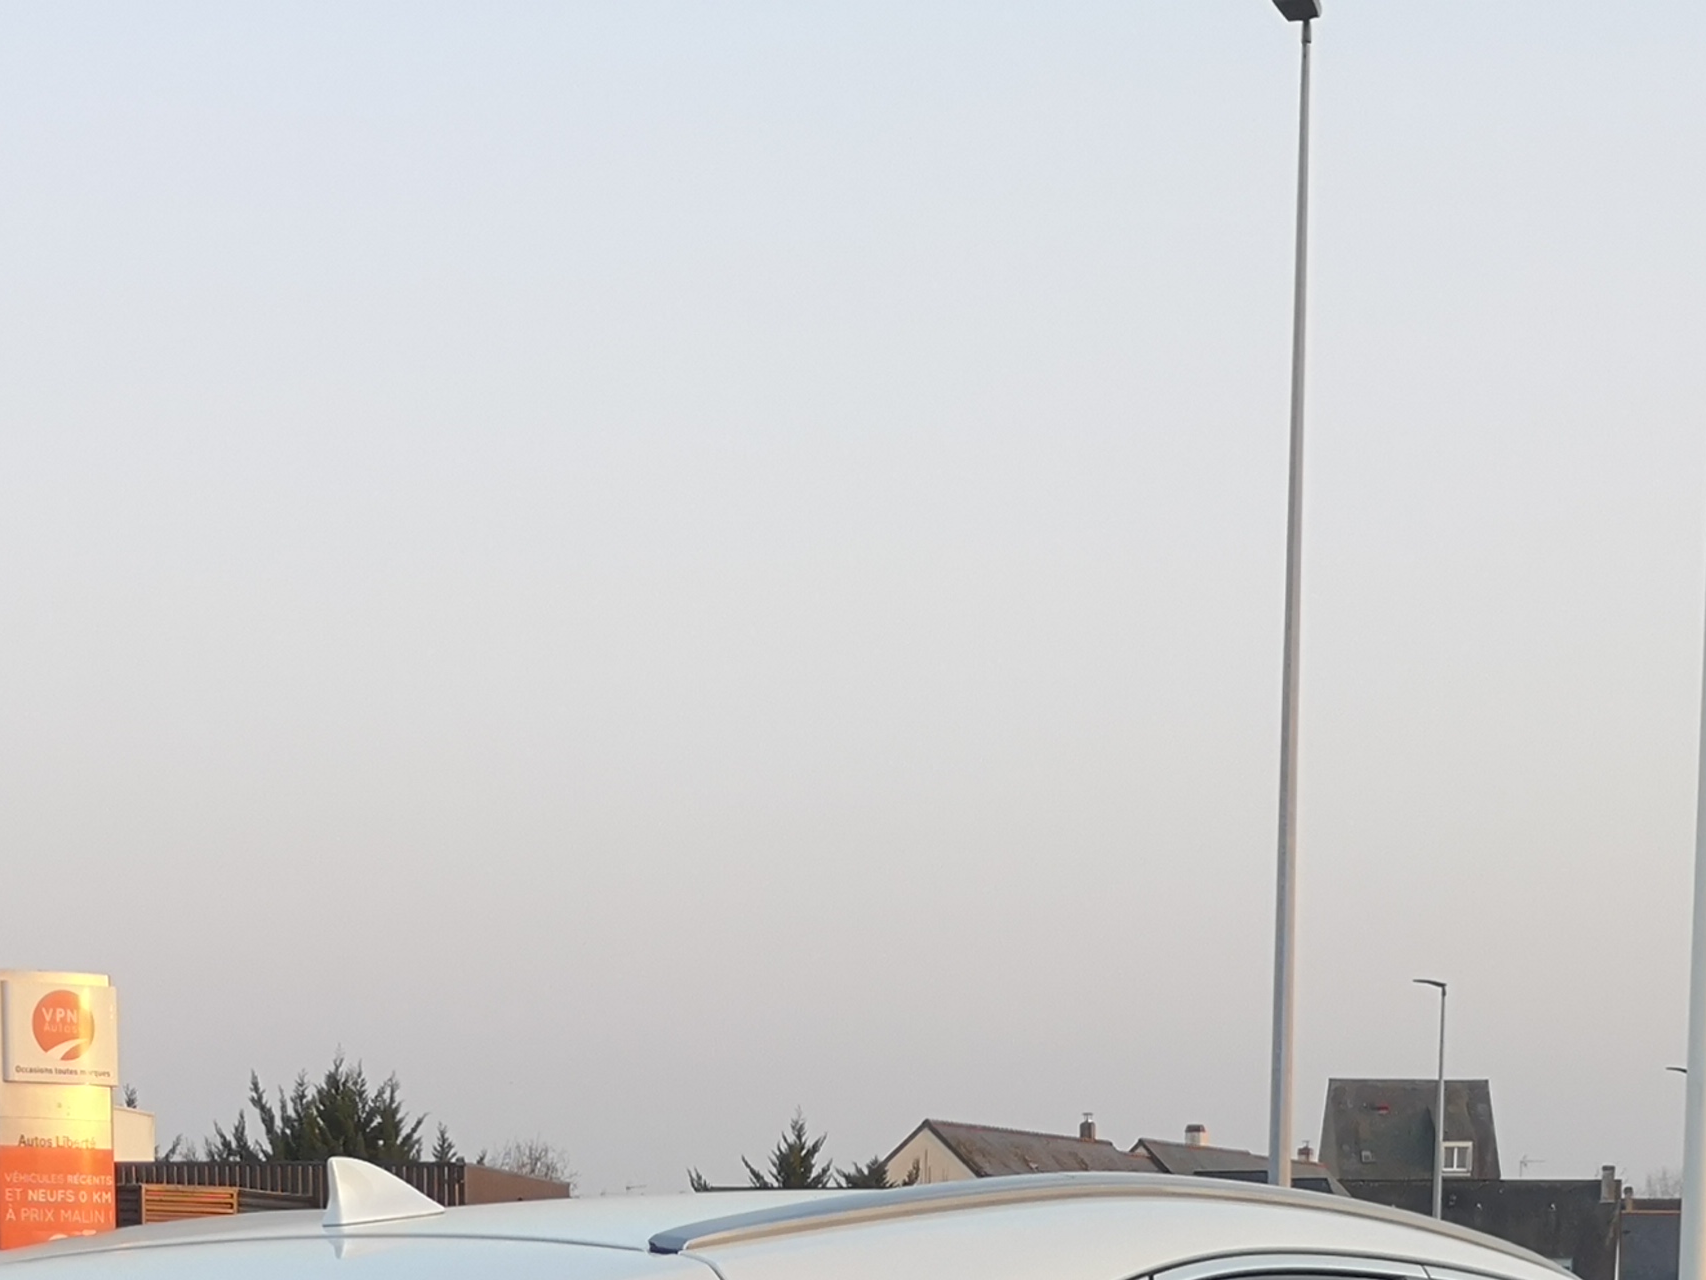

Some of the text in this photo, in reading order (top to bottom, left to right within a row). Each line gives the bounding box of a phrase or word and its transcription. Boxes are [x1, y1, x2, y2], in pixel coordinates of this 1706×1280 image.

[41, 1007, 78, 1023] VPN
[15, 1065, 111, 1078] Occasions toutes mrques
[17, 1133, 98, 1150] Autos Liberté
[4, 1170, 113, 1187] VÉHICULES RÉCENTS
[4, 1187, 24, 1202] ET
[27, 1189, 76, 1203] NEUFS
[92, 1191, 112, 1204] KM
[20, 1207, 55, 1223] PRIX
[60, 1209, 105, 1224] MALIN
